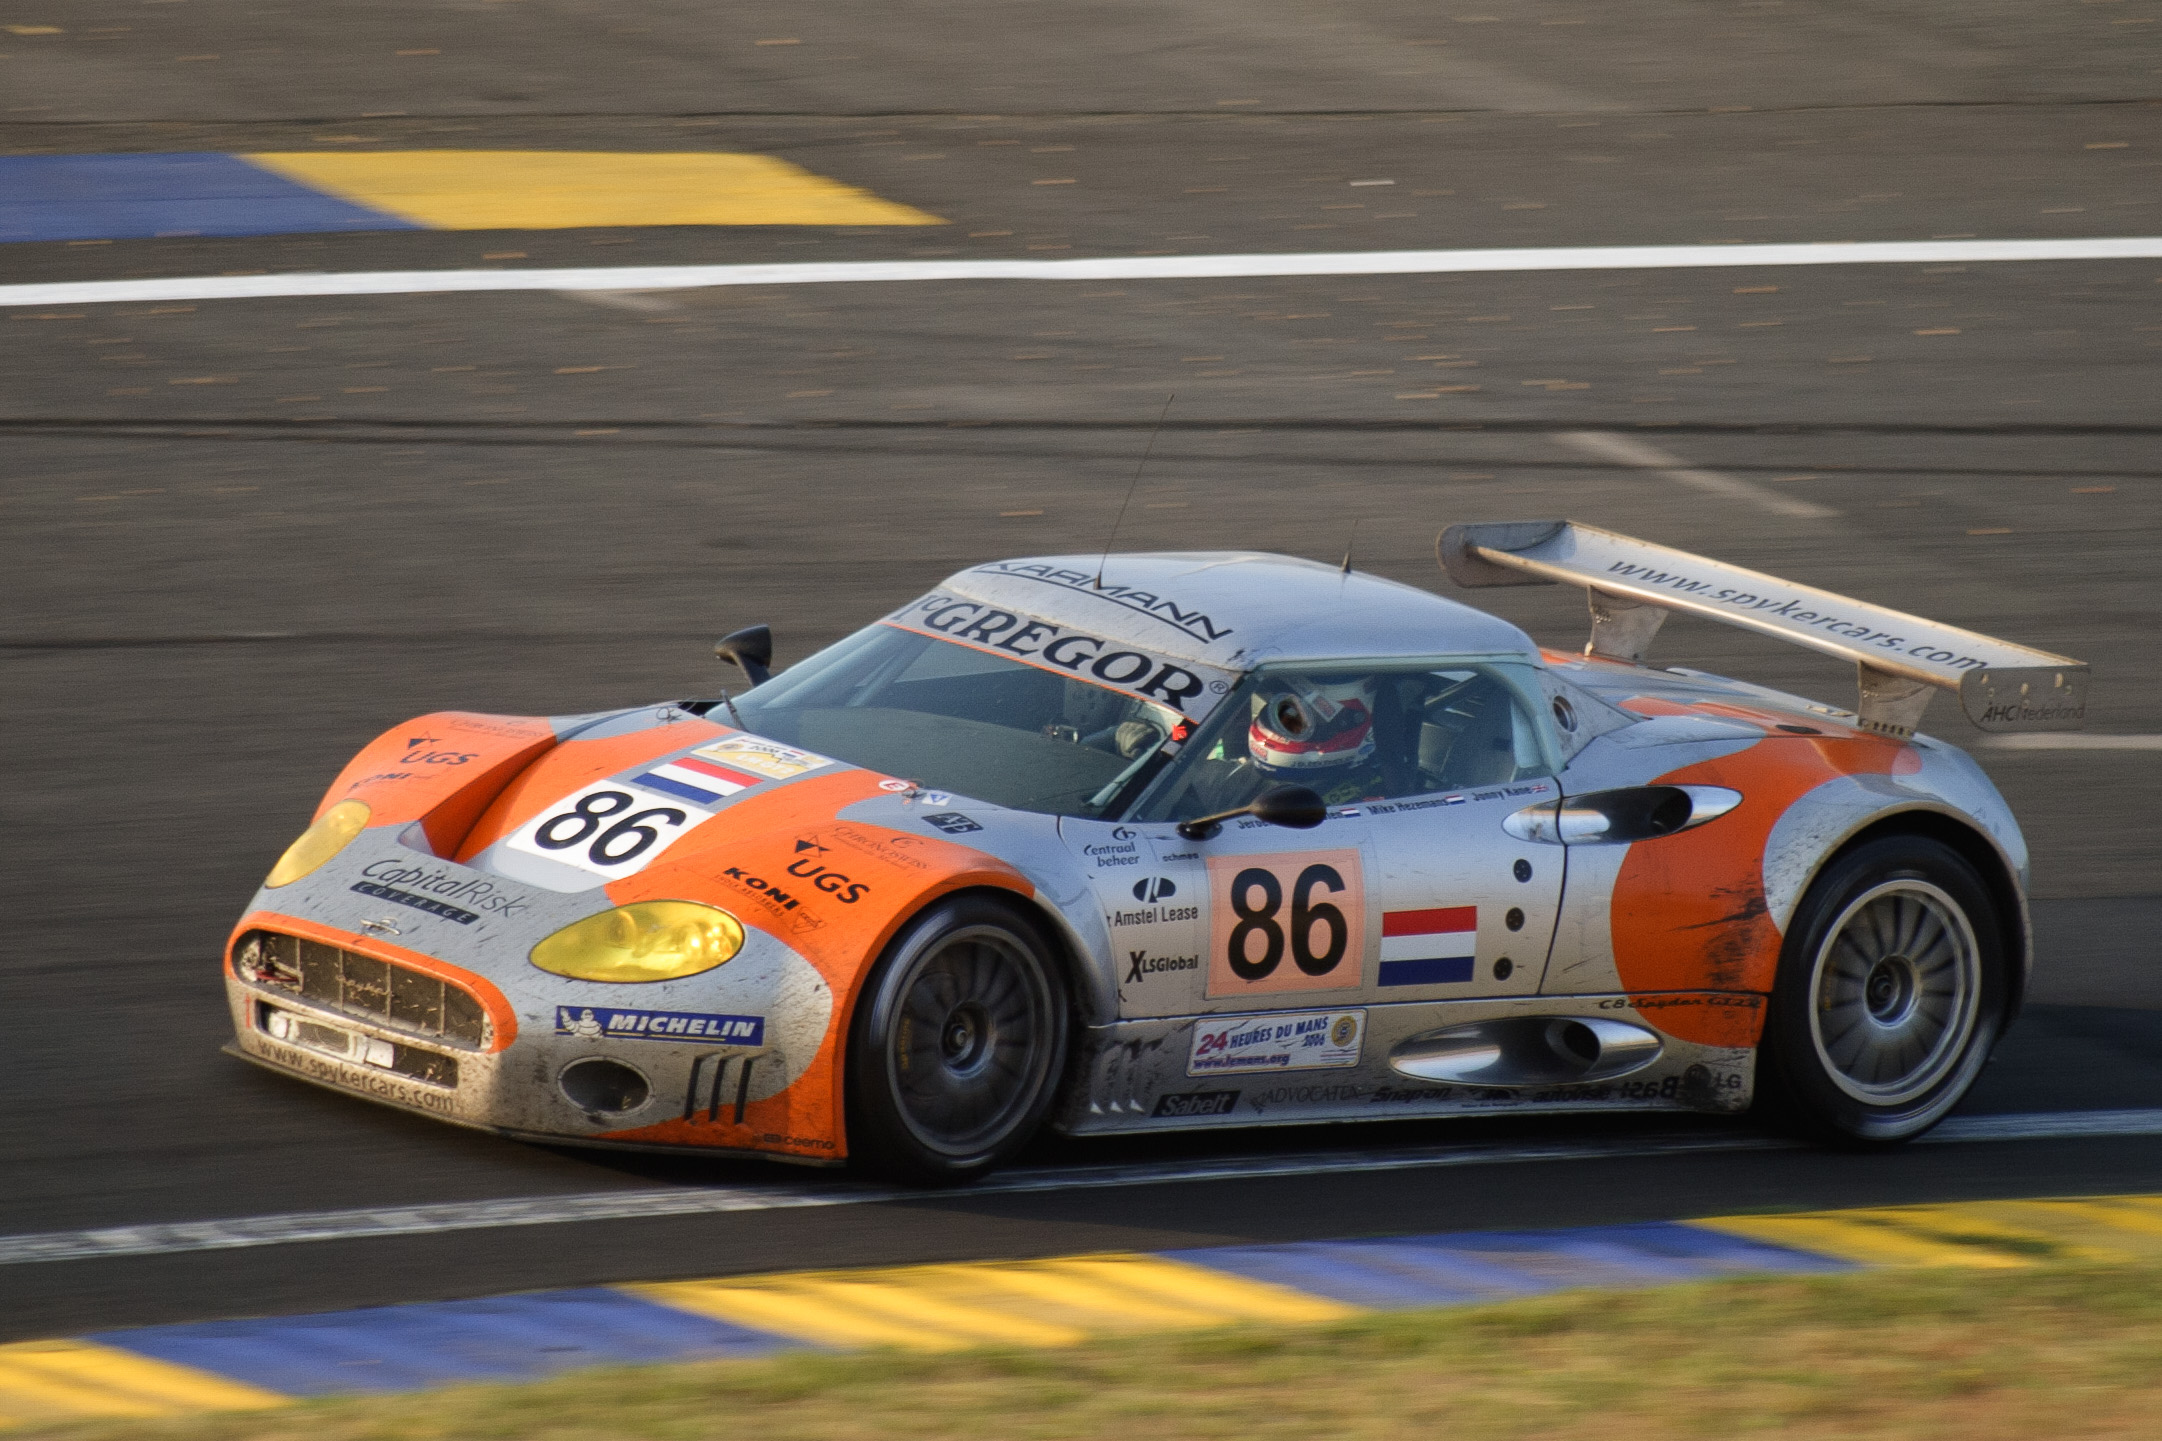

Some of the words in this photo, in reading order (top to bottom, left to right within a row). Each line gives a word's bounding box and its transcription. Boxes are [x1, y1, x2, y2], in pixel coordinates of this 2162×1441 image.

[976, 562, 1234, 640] KARMANN
[1608, 560, 1987, 669] www.spykercars.com
[400, 750, 479, 765] UGS
[535, 790, 687, 866] 86
[1366, 804, 1396, 816] Mike
[1083, 841, 1136, 856] Centraal
[1096, 854, 1141, 868] beheer
[361, 859, 525, 917] CapitalRisk
[723, 867, 801, 911] KONI
[786, 858, 870, 904] UGS
[357, 883, 474, 922] COVERAGE
[1114, 907, 1157, 927] Amstel
[1161, 905, 1199, 923] Lease
[1228, 863, 1348, 980] 86
[1125, 950, 1200, 984] XLSGlobal
[608, 1013, 757, 1038] MICHELIN
[1195, 1030, 1229, 1056] 24
[1229, 1026, 1273, 1049] HEURES
[1275, 1023, 1293, 1040] DU
[1295, 1016, 1329, 1036] MANS
[257, 1038, 455, 1111] www.spykercars.com
[1193, 1053, 1291, 1070] www.lemans.org
[1161, 1091, 1230, 1115] Sabelt
